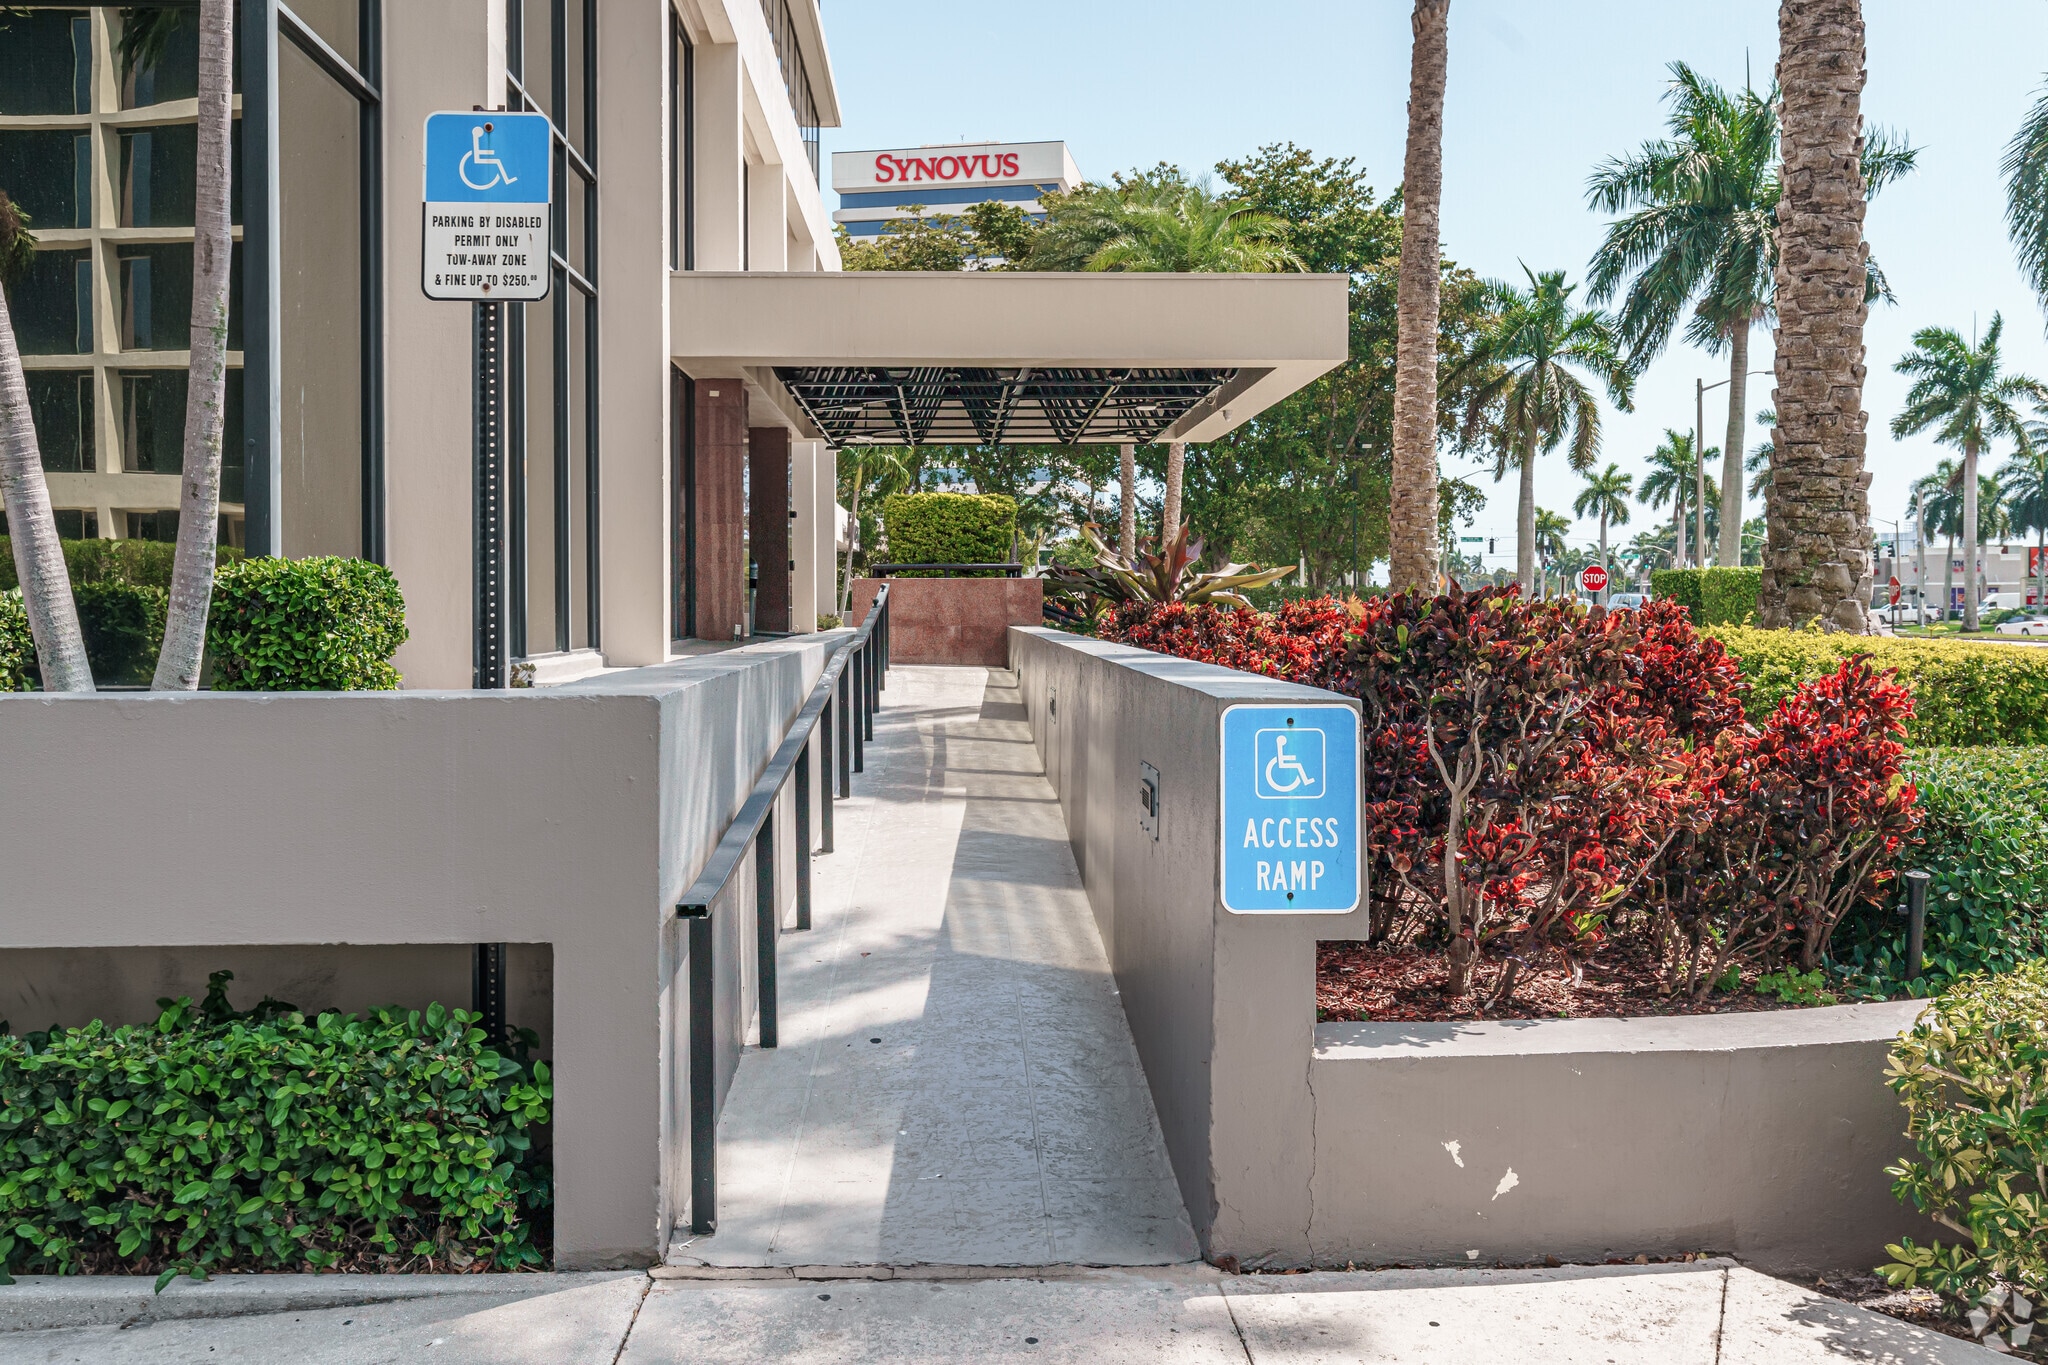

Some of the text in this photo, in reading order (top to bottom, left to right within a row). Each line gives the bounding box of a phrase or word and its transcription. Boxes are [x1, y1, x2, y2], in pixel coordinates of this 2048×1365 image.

[875, 153, 1020, 183] SYNOVUS
[432, 216, 542, 229] PARKING BY DISABLED
[454, 235, 519, 247] PERMIT ONLY
[446, 254, 527, 266] TOW-AWAY ZONE
[435, 274, 441, 286] &
[445, 274, 467, 286] FINE
[470, 274, 482, 286] UP
[486, 274, 498, 287] TO
[1583, 573, 1607, 584] STOP
[1243, 817, 1339, 848] ACCESS
[1256, 860, 1325, 891] RAMP
